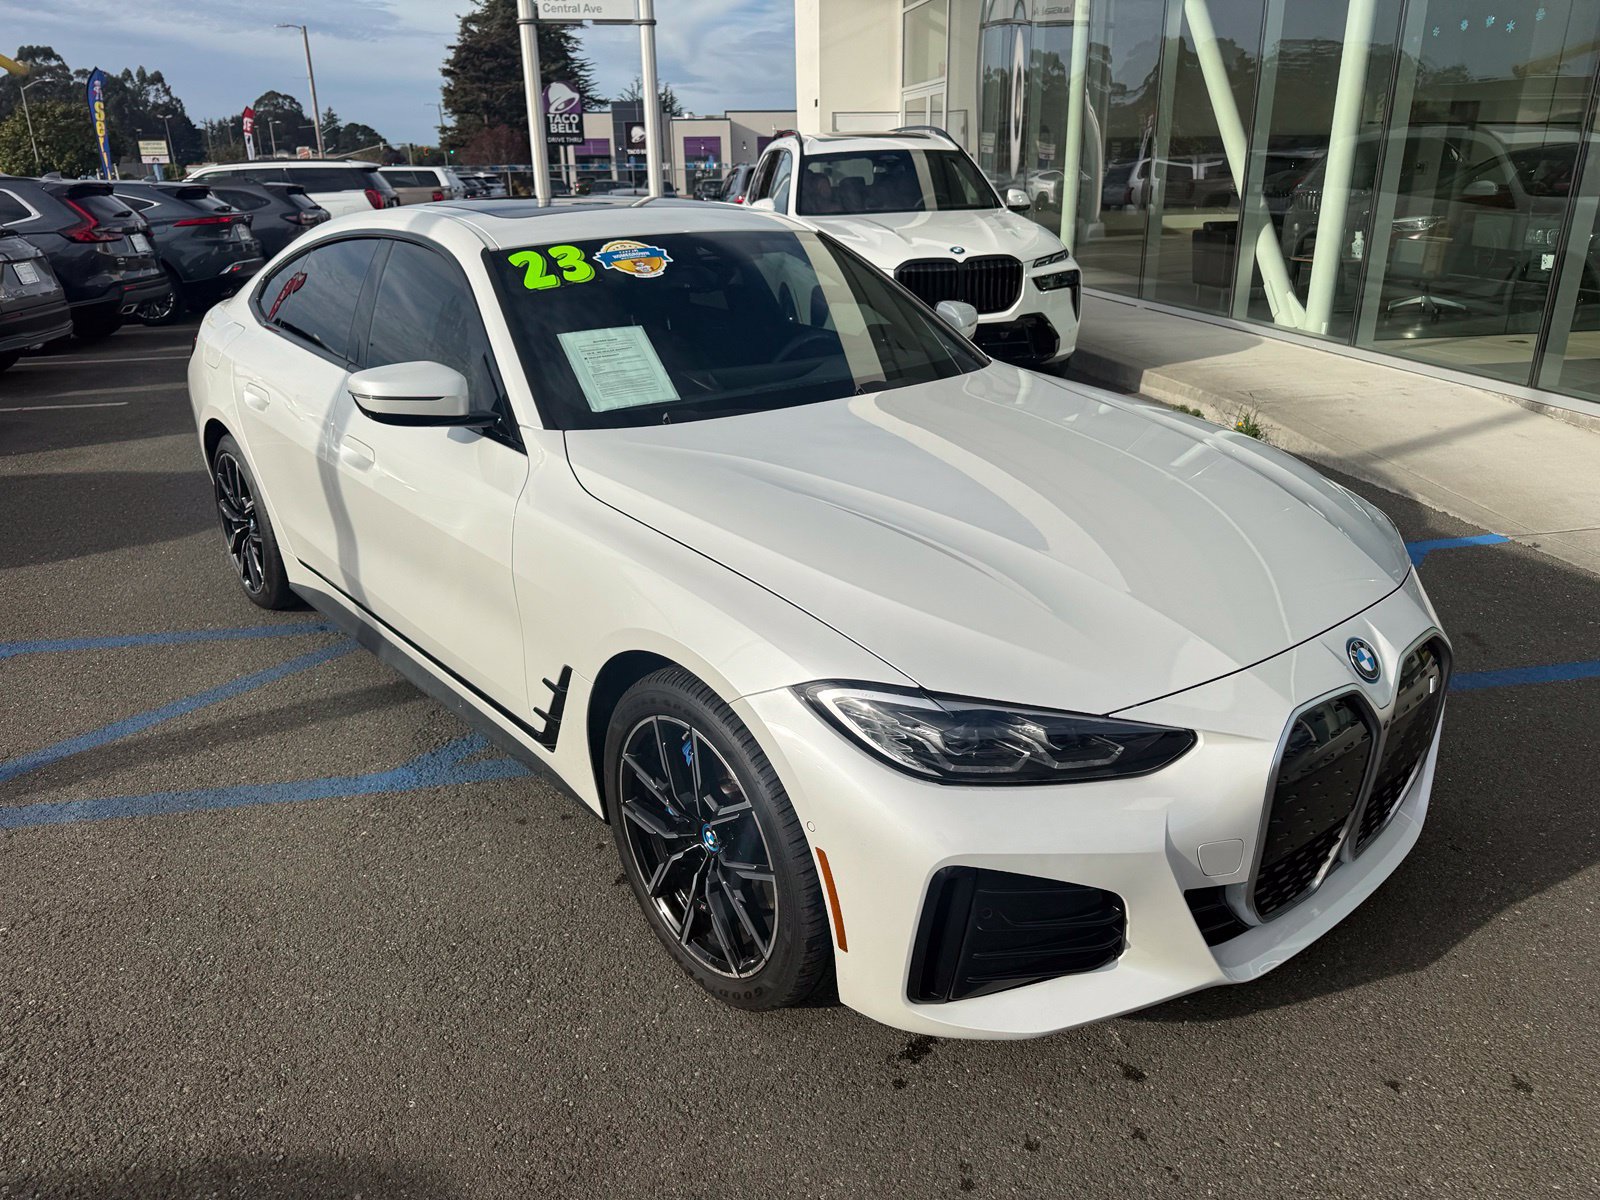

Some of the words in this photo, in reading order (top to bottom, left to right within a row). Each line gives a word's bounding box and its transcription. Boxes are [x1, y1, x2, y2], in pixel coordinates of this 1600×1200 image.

[543, 3, 580, 13] Central
[583, 3, 602, 13] Ave
[547, 114, 579, 123] TACO
[550, 124, 579, 133] BELL
[508, 245, 595, 290] 23
